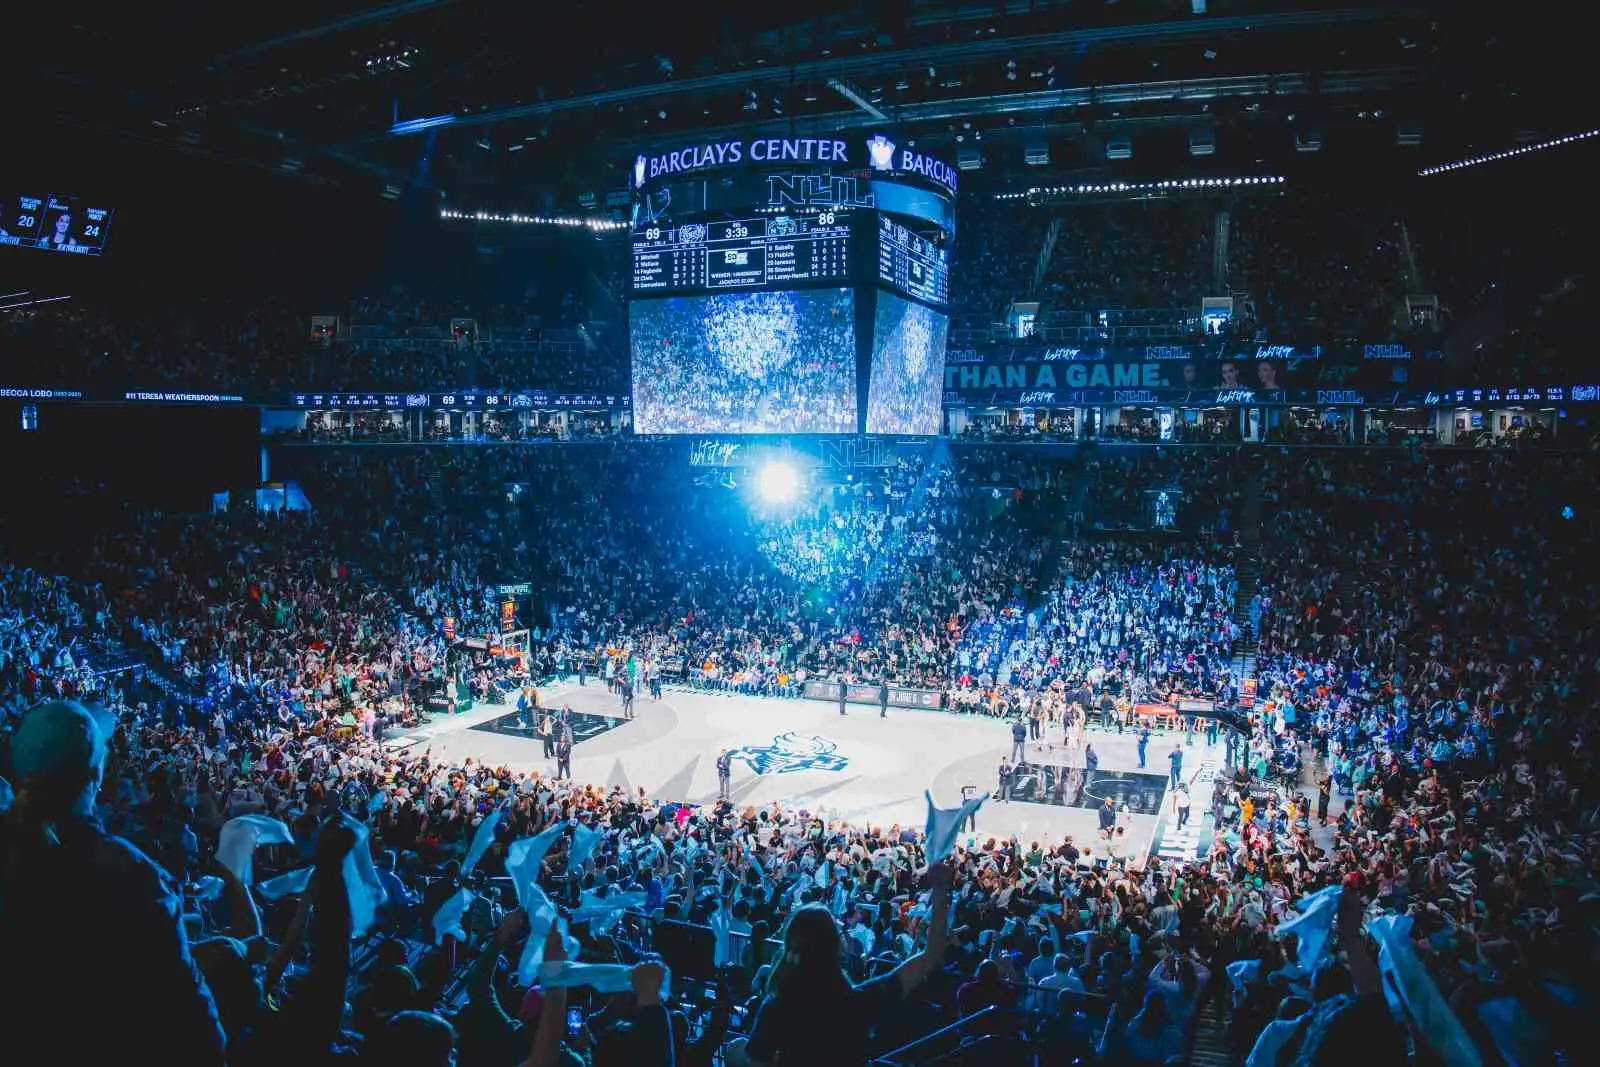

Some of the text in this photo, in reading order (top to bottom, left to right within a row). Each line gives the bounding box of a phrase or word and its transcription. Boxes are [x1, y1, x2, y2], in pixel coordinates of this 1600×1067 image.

[649, 138, 848, 177] BARCLAYS CENTER
[17, 215, 34, 228] 20
[819, 212, 834, 225] 86
[84, 225, 100, 237] 24
[646, 227, 660, 239] 69
[725, 227, 748, 239] 3:39
[944, 363, 1170, 388] THAN A GAME.
[30, 389, 53, 398] LOBO
[165, 394, 220, 402] WEATHERSPOON
[442, 395, 455, 405] 69
[486, 395, 498, 405] 86
